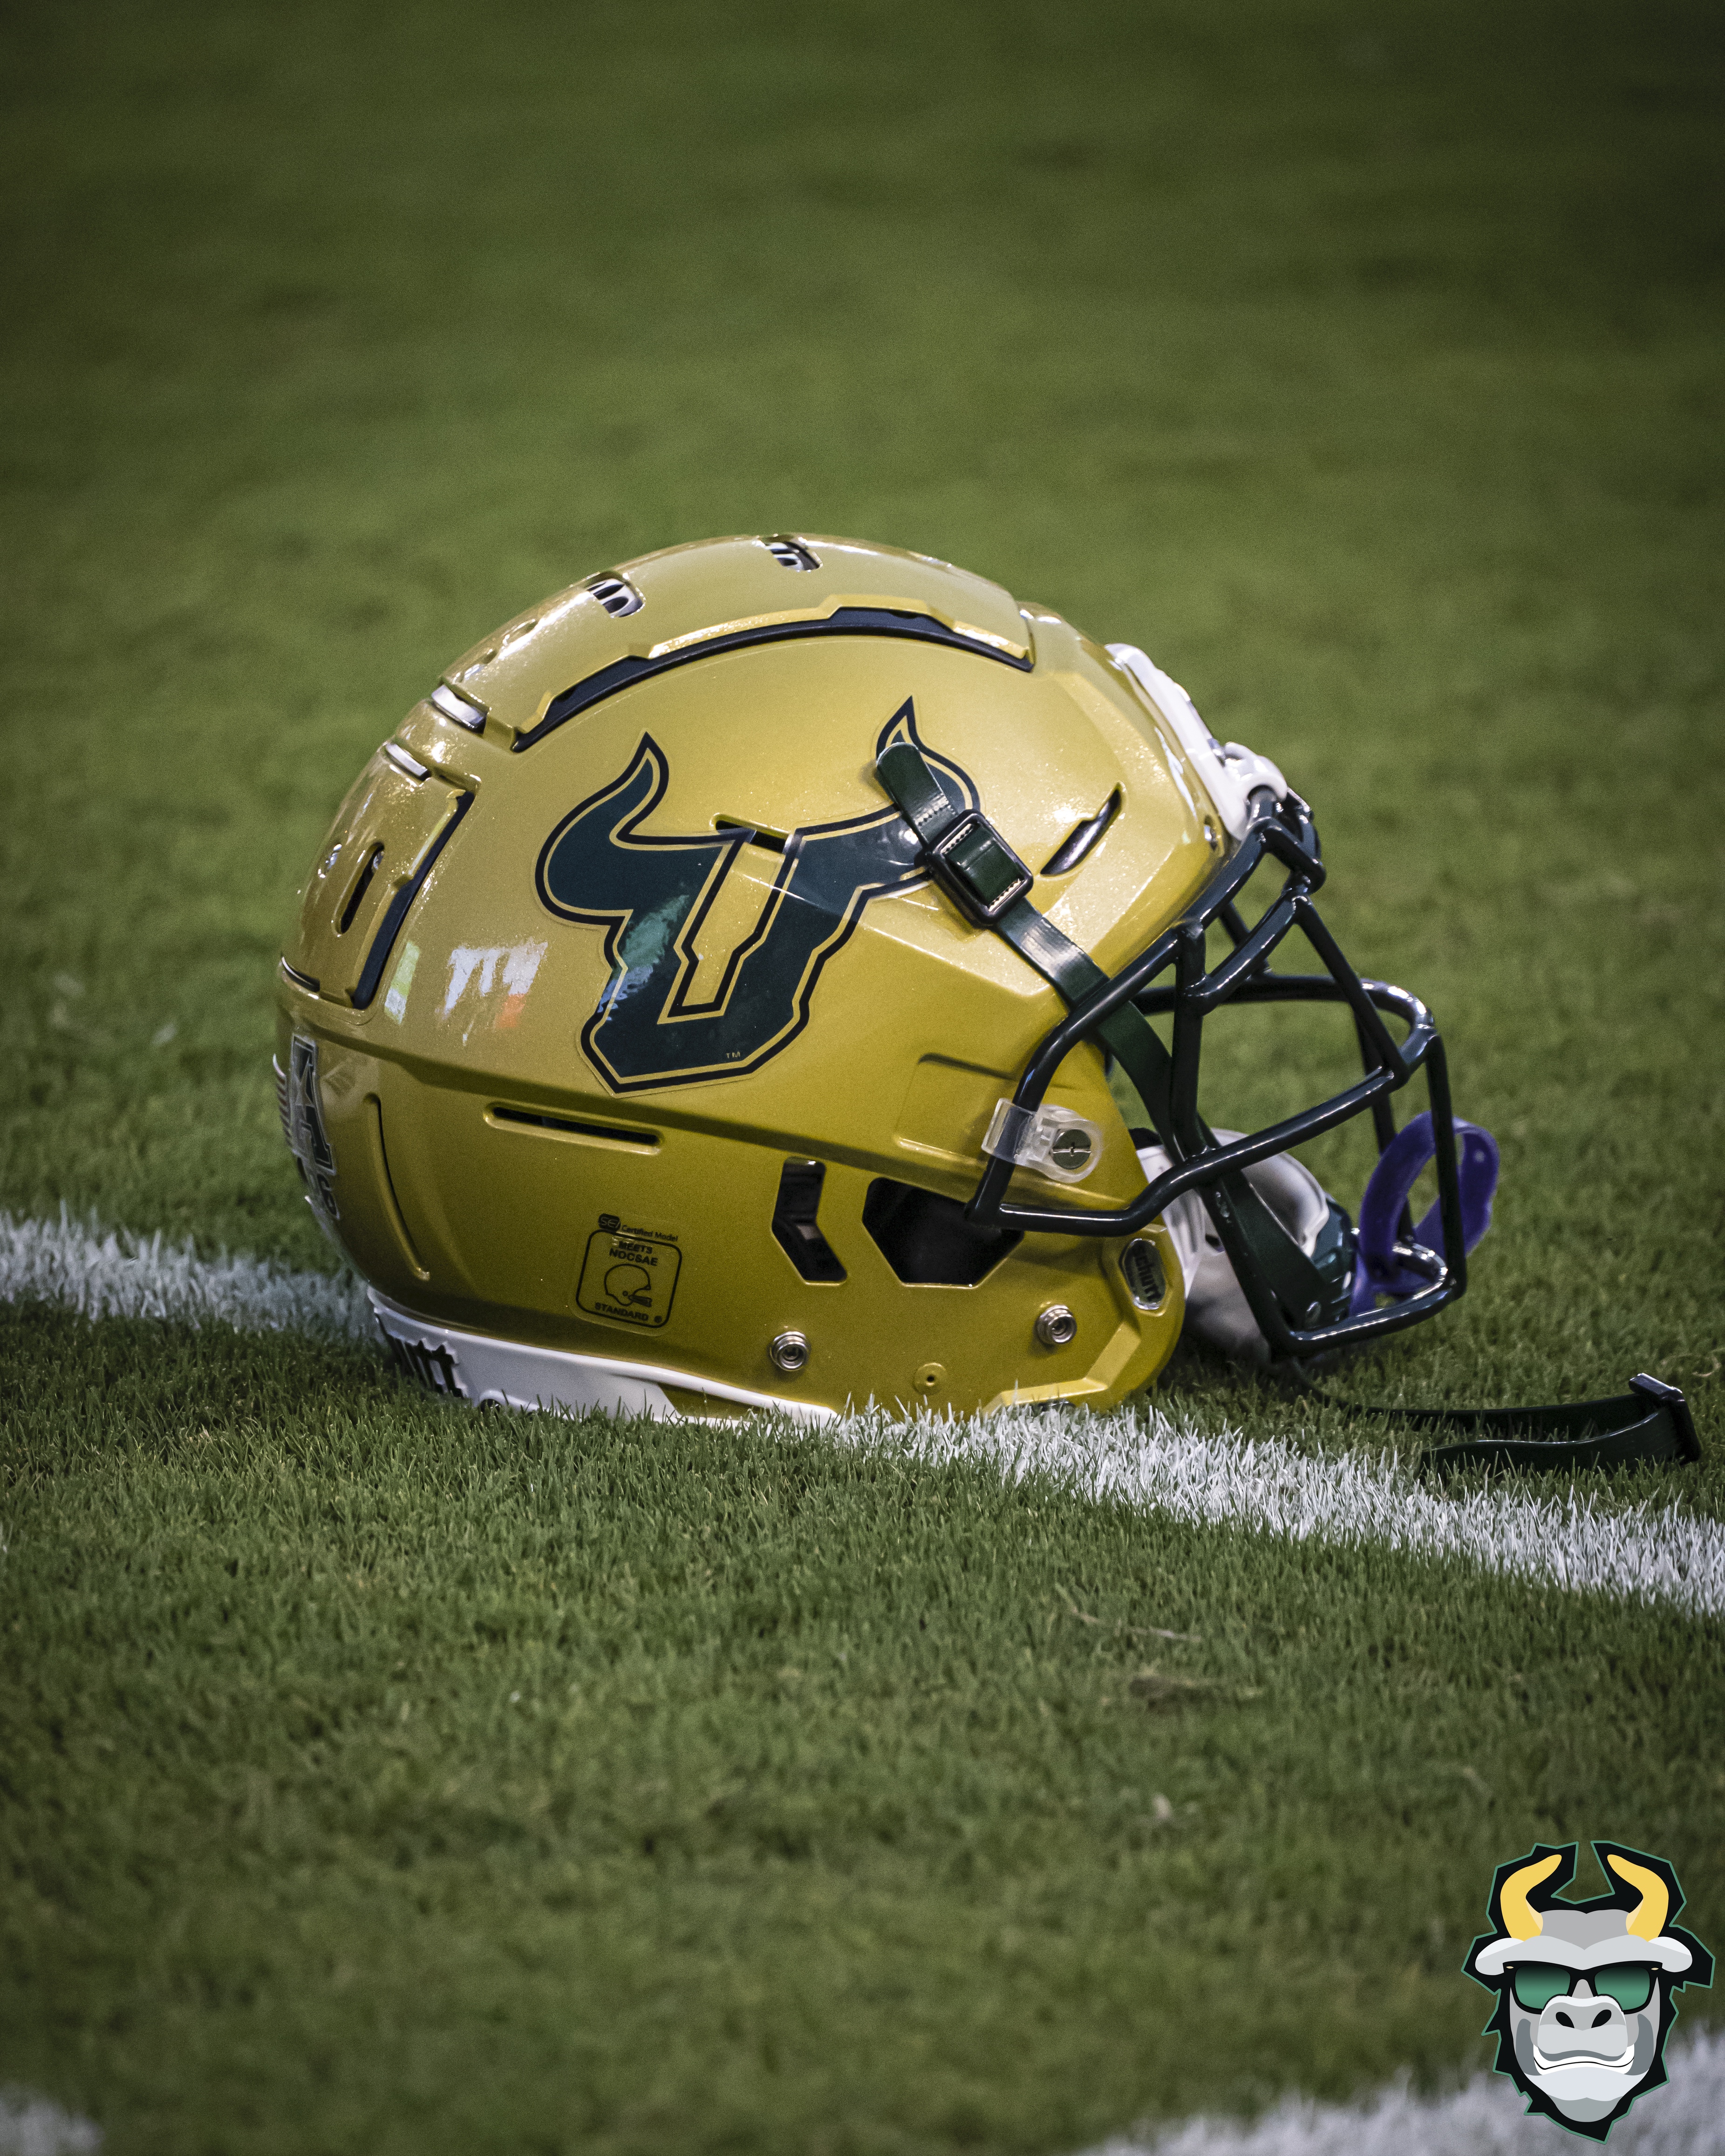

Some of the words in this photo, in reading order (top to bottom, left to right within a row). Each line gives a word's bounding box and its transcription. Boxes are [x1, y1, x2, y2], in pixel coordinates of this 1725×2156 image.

[622, 1224, 653, 1237] Certified
[655, 1231, 678, 1242] Model
[618, 1241, 653, 1254] MEETS
[609, 1248, 658, 1266] NOCSAE
[594, 1302, 649, 1321] STANDARD
